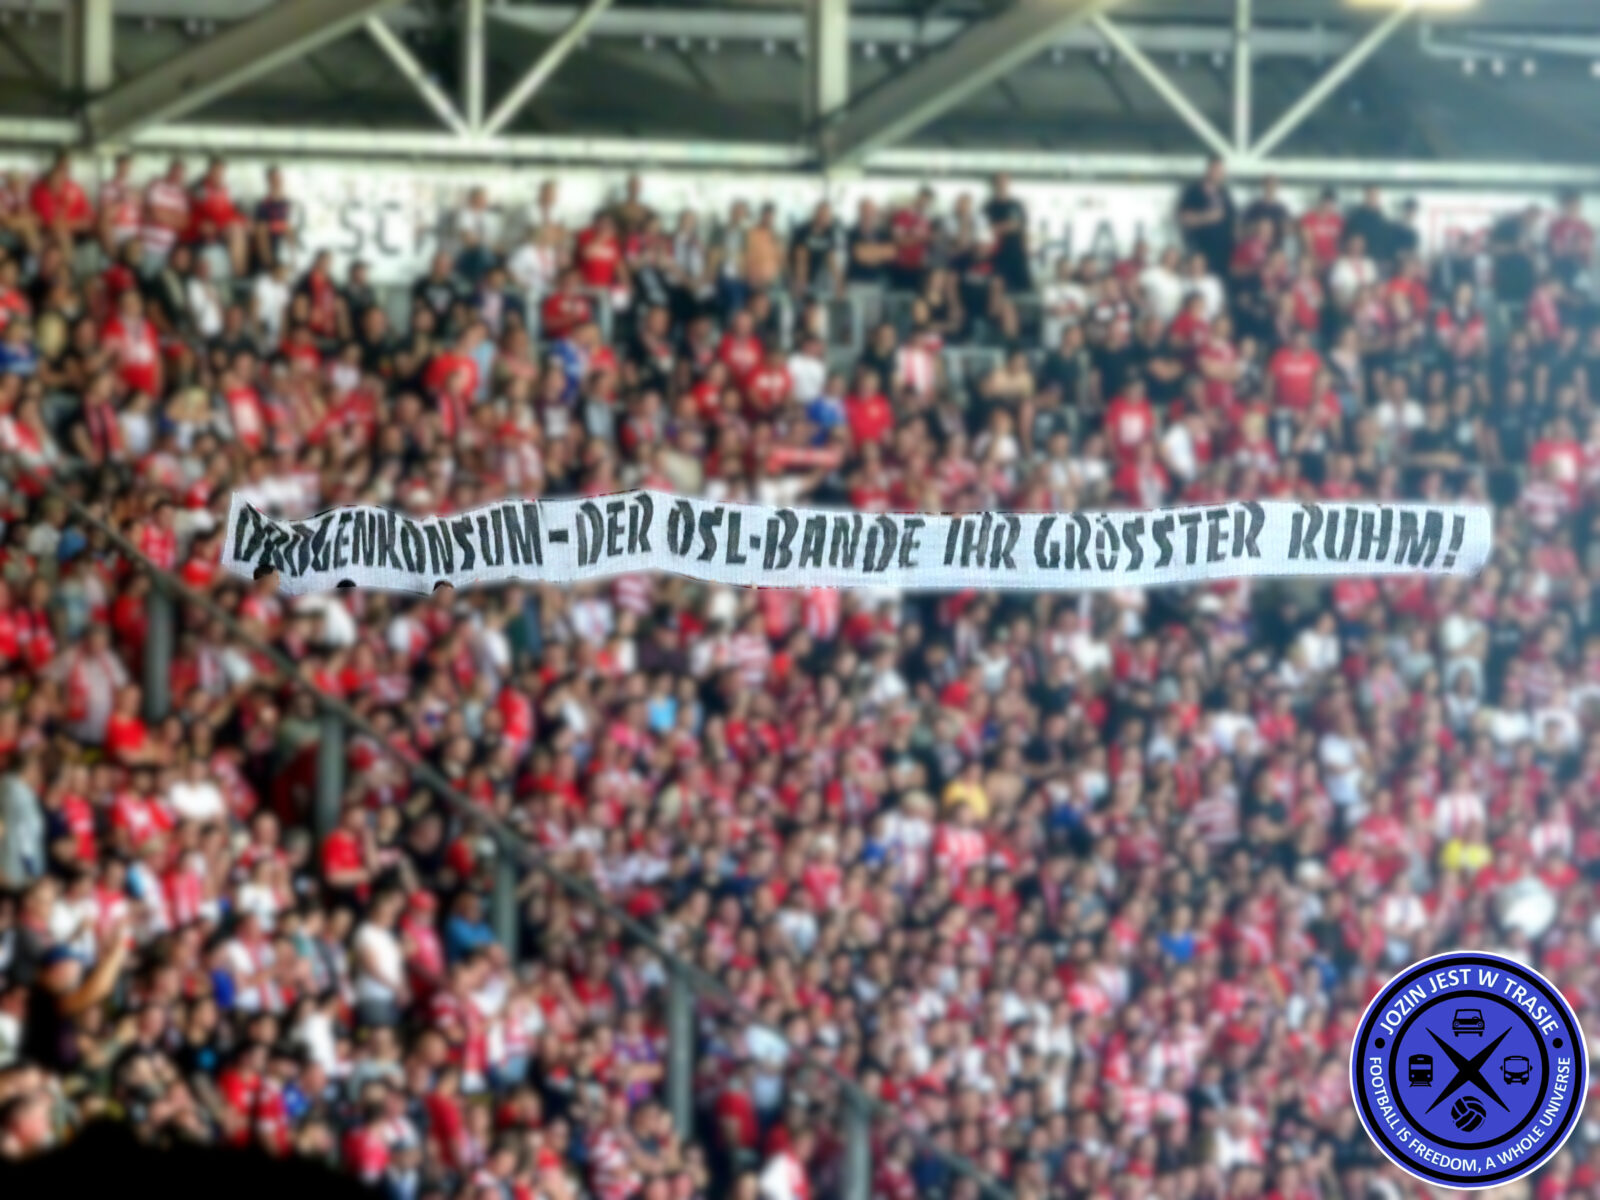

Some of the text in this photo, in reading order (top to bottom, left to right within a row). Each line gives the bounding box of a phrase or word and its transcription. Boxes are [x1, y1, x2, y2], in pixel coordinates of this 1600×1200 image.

[667, 500, 925, 573] OSL-BANDE
[943, 512, 1021, 569] IHR
[1034, 502, 1265, 571] GRÖSSTER
[1287, 502, 1465, 568] RUHM!
